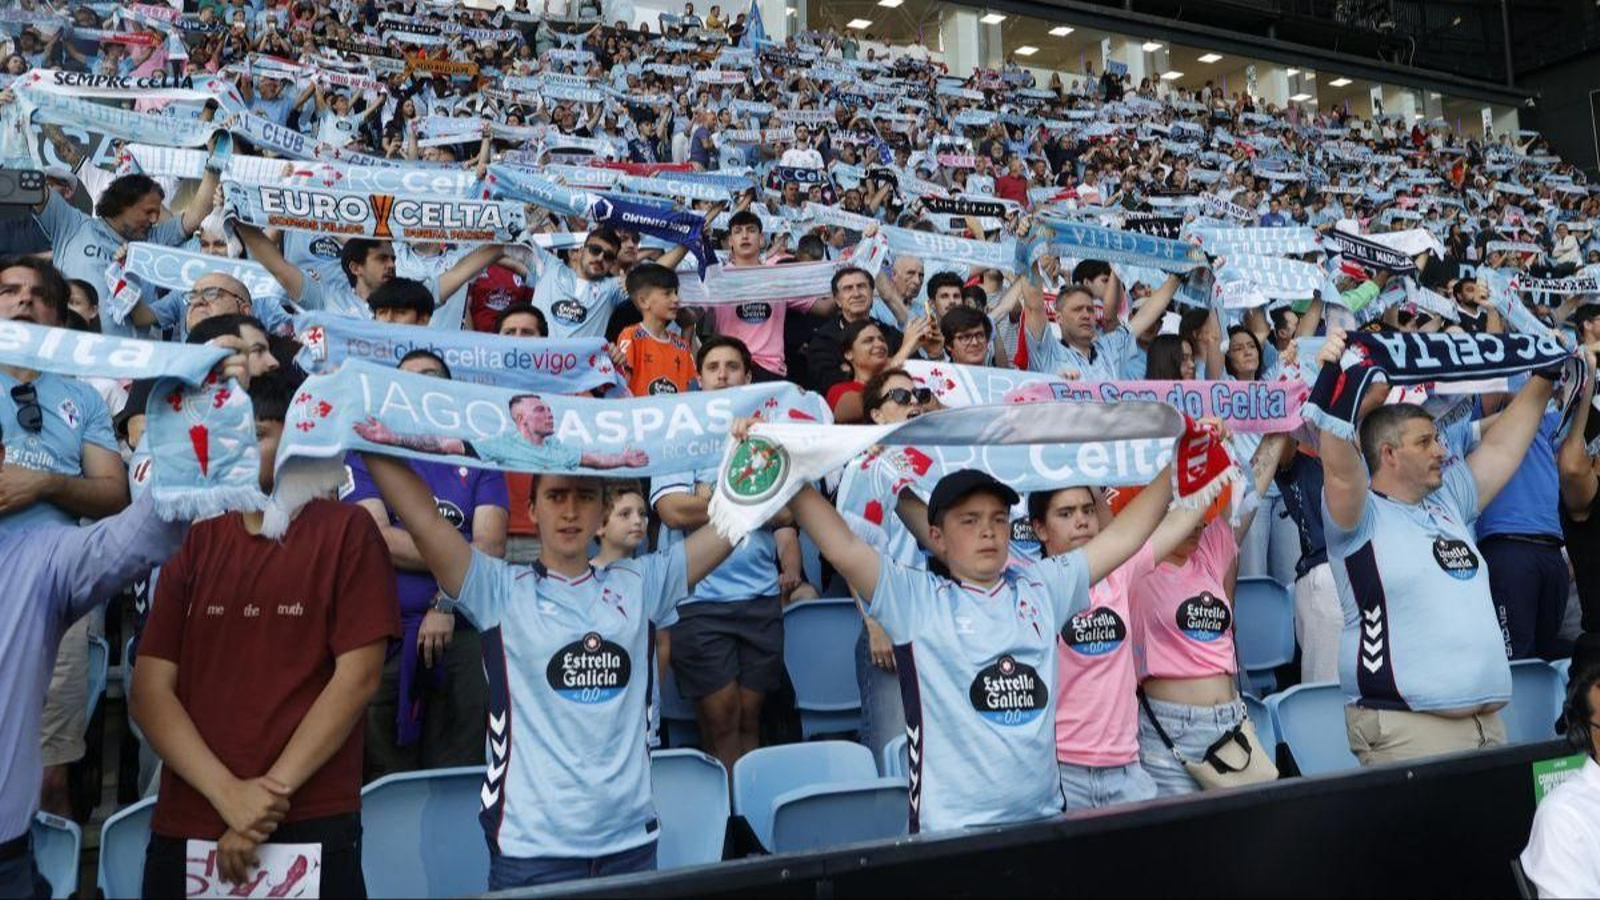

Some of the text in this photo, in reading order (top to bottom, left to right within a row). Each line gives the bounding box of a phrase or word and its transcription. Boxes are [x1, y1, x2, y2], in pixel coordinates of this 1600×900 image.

[54, 71, 194, 89] SEMPRE CELTA
[262, 123, 305, 152] CLUB
[258, 186, 505, 230] EURO CELTA
[622, 211, 667, 229] DINAMO
[1072, 227, 1137, 253] CELTA
[1372, 331, 1505, 369] CELTA
[360, 372, 733, 444] IAGO ASPAS
[1210, 382, 1287, 420] Celta
[207, 605, 225, 616] me
[243, 603, 260, 617] the
[1186, 603, 1226, 620] Estrella
[1072, 613, 1117, 630] Estrella
[1187, 617, 1222, 631] Galicia
[1075, 627, 1117, 642] Galicia
[562, 652, 622, 670] Estrella
[563, 669, 618, 688] Galicia
[983, 674, 1035, 692] Estrella
[986, 690, 1035, 709] Galicia
